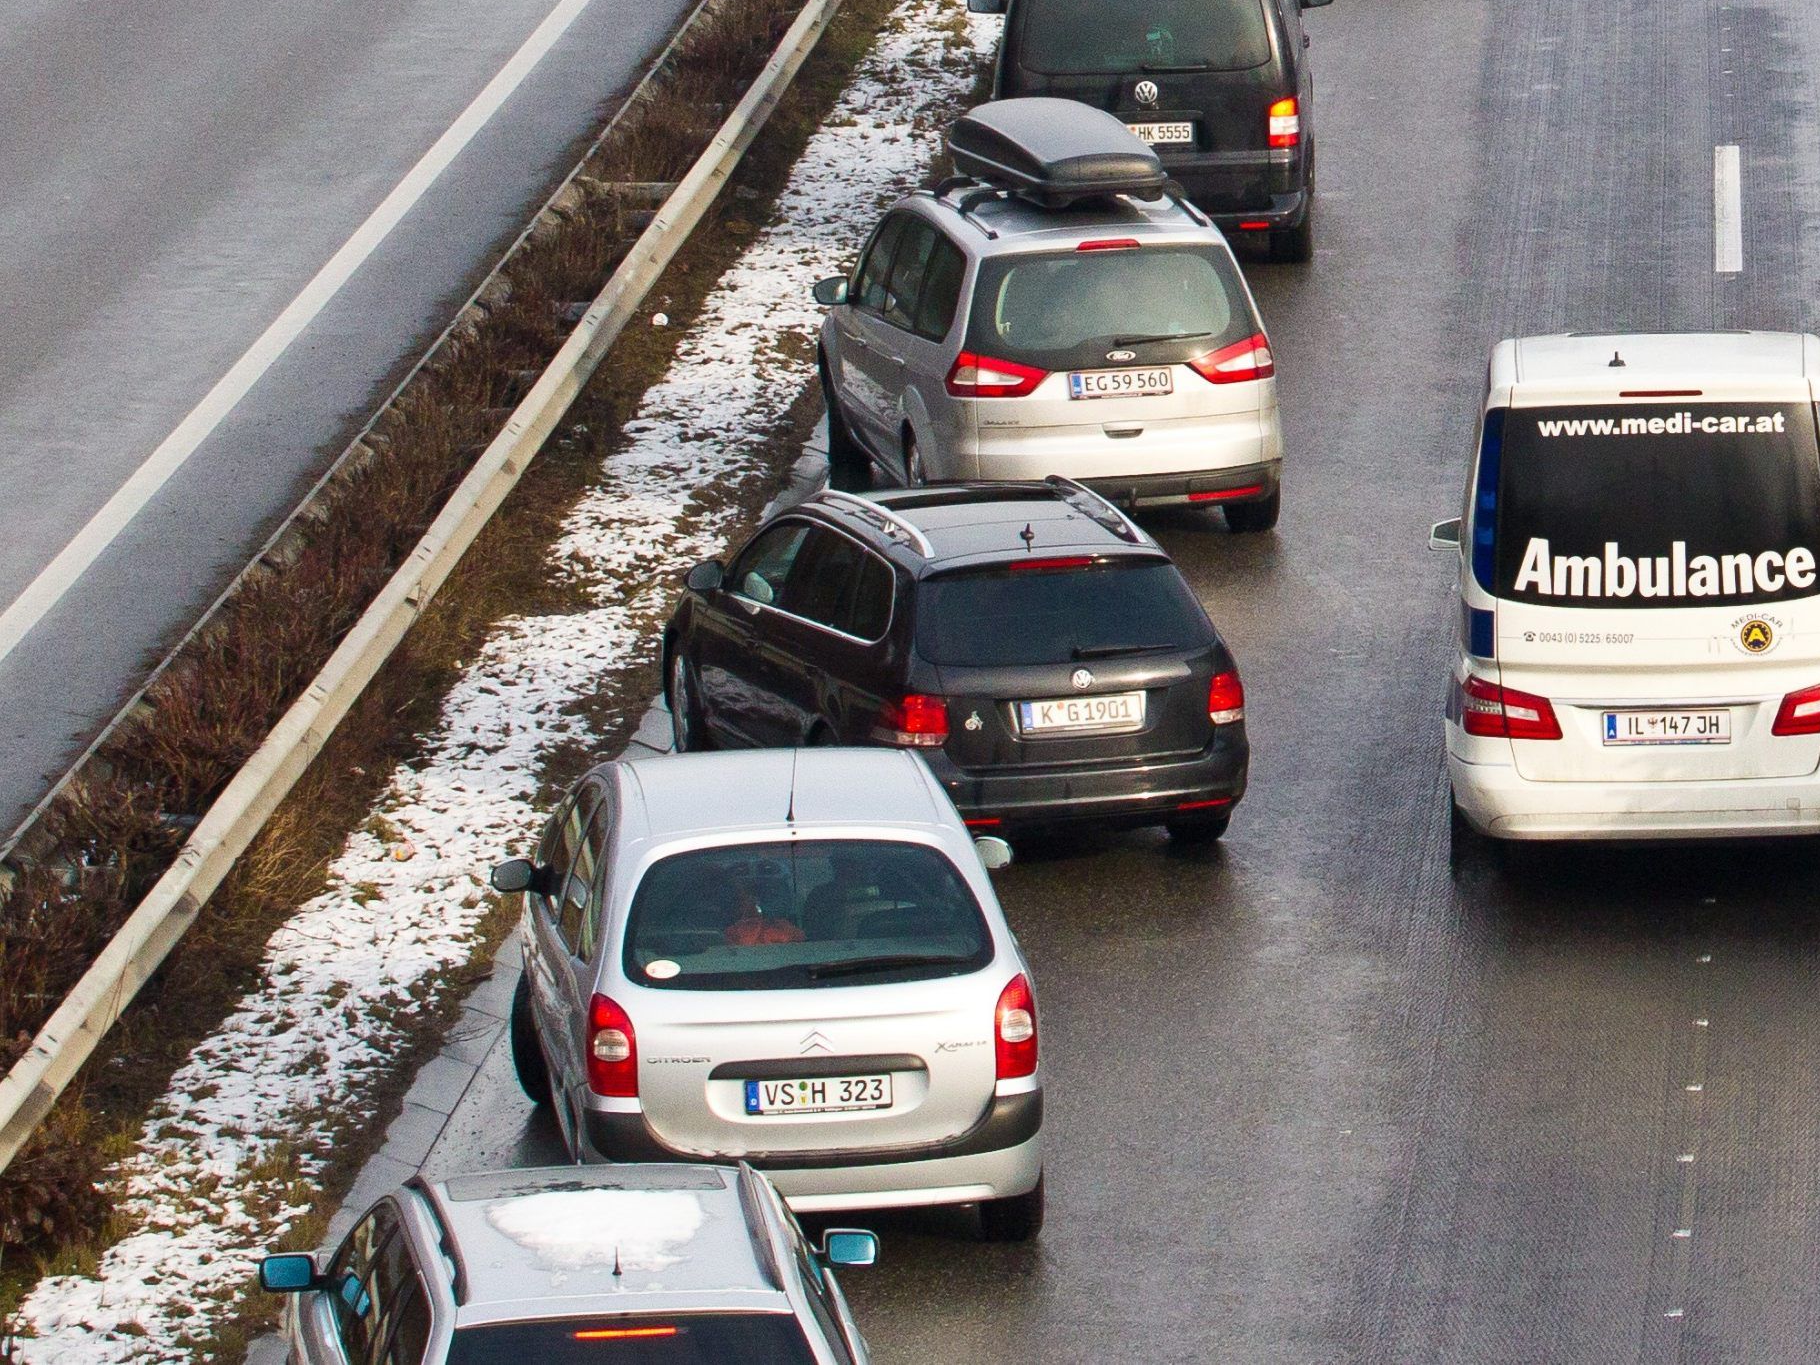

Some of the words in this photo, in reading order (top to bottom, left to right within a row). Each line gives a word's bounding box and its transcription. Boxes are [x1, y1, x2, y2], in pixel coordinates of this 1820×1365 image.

[1158, 125, 1190, 140] 5555
[1085, 376, 1107, 391] EG
[1112, 375, 1132, 390] 59
[1138, 372, 1168, 388] 560
[1538, 411, 1785, 437] www.medi-car.at
[1514, 537, 1817, 597] Ambulance
[1539, 632, 1562, 643] 0043
[1565, 632, 1577, 643] (0)
[1579, 633, 1601, 644] 5225
[1605, 634, 1634, 644] 65007
[1041, 705, 1053, 724] K
[1067, 703, 1079, 722] G
[1085, 700, 1132, 721] 1901
[1629, 717, 1644, 735] IL
[1660, 716, 1691, 735] 147
[1697, 716, 1719, 734] JH
[765, 1083, 795, 1106] VS
[812, 1081, 826, 1103] H
[840, 1079, 883, 1102] 323
